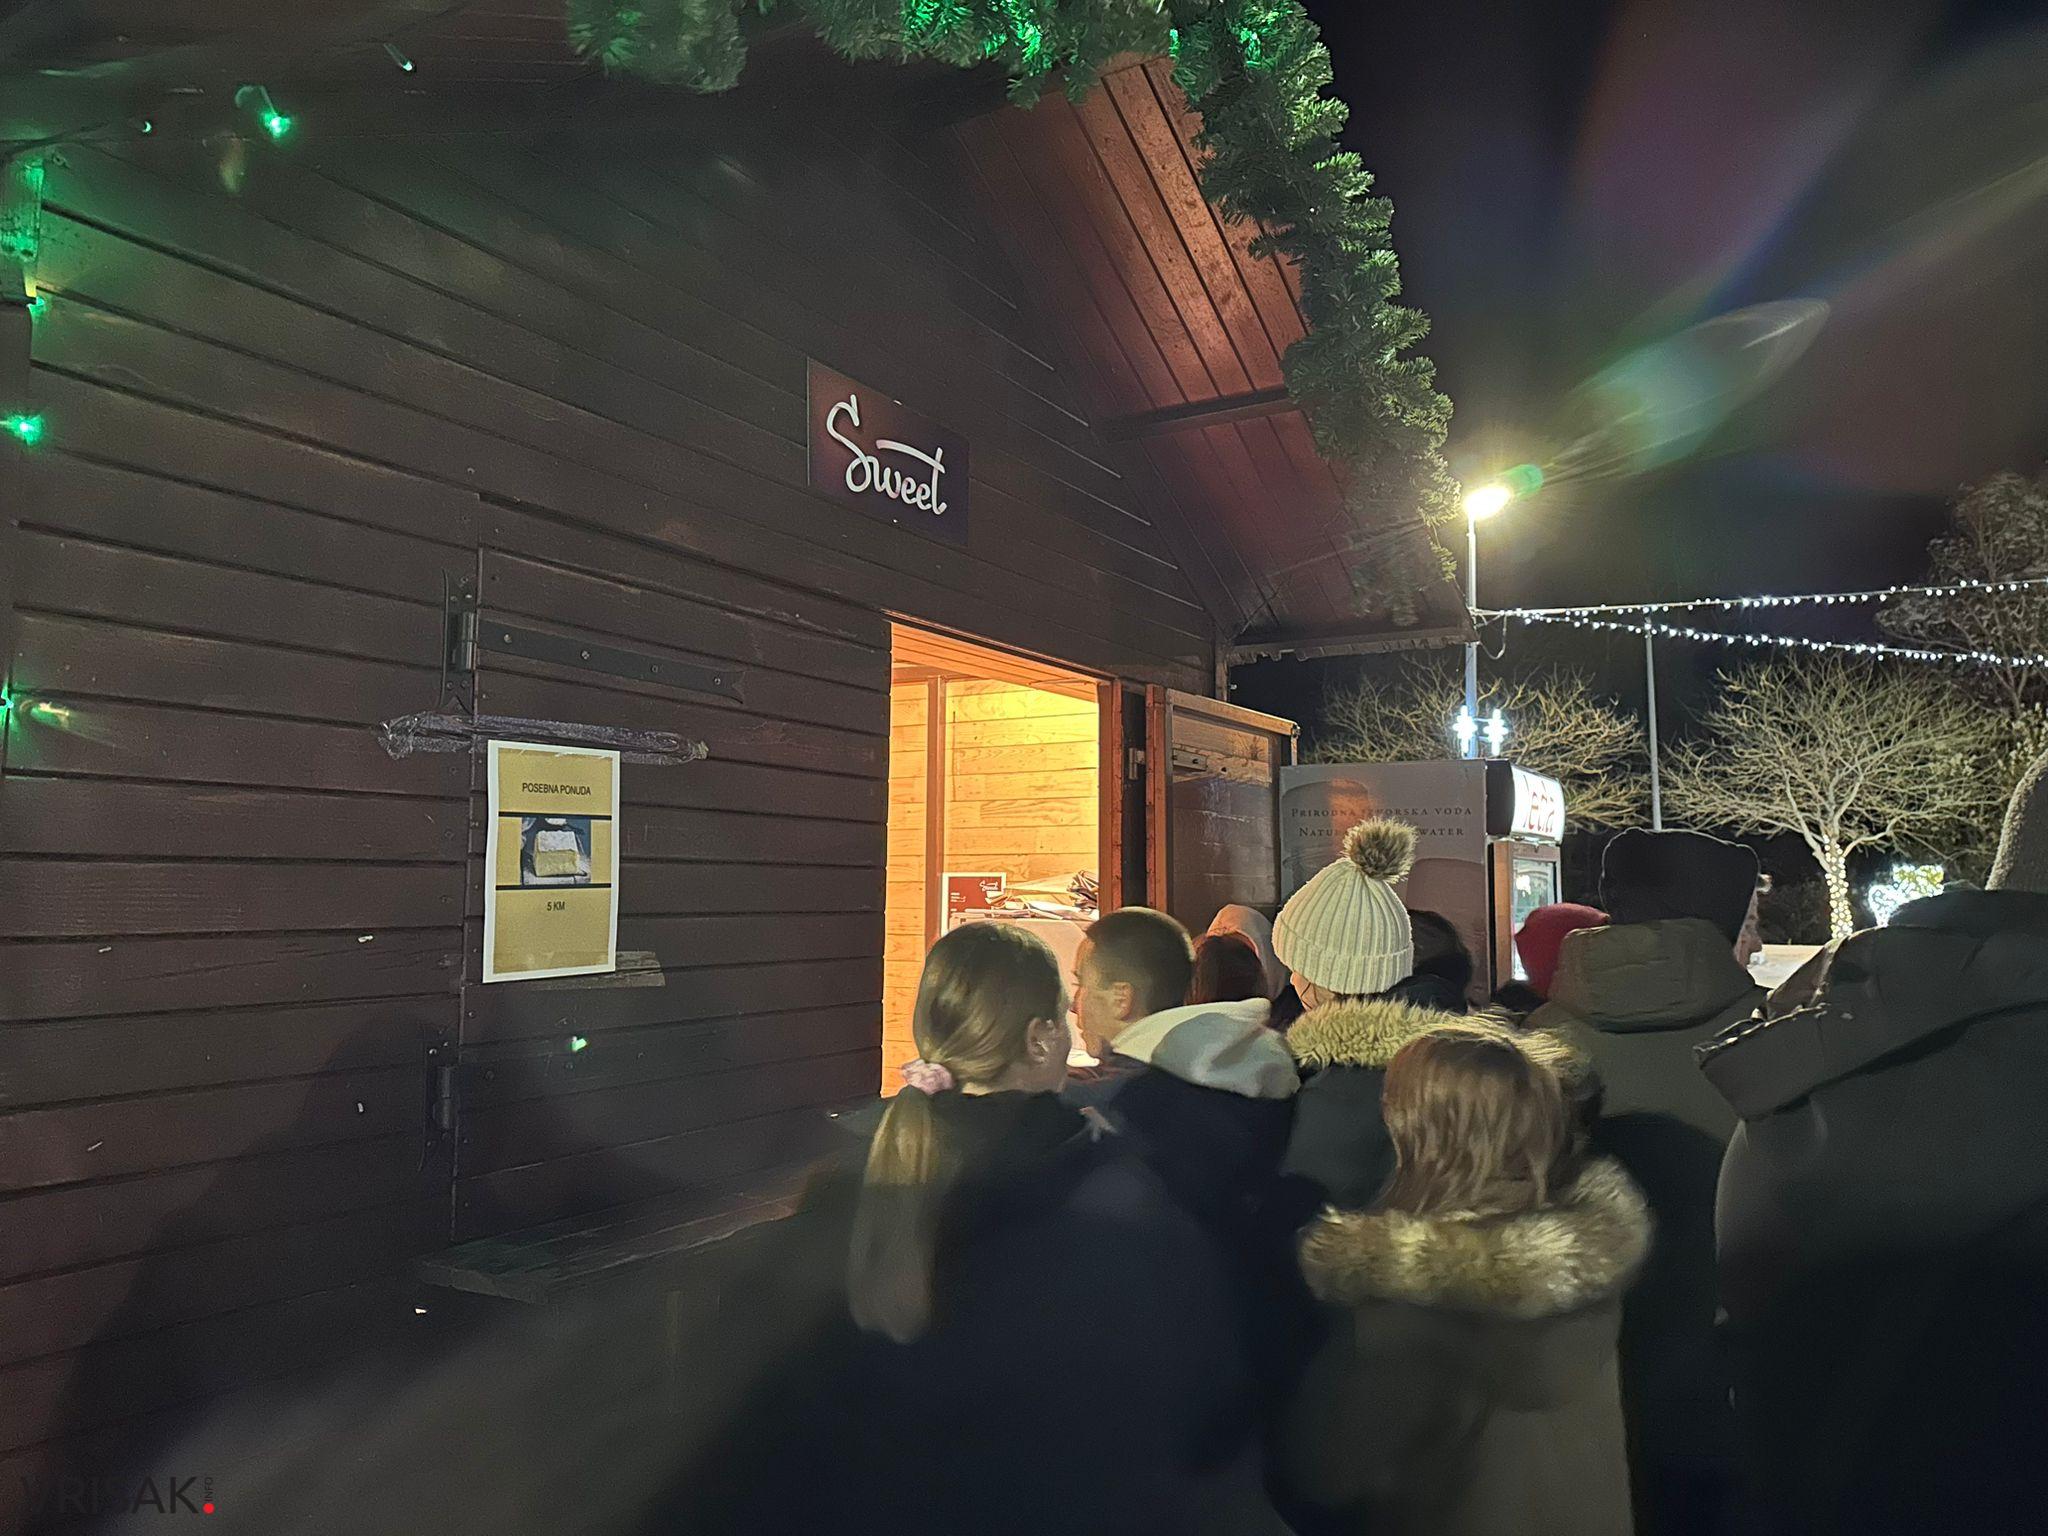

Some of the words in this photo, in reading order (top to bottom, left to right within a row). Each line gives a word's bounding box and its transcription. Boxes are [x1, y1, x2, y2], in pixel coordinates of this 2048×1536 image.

[826, 394, 948, 515] Sweet
[522, 782, 559, 794] POSEBNA
[560, 784, 591, 795] PONUDA
[1291, 807, 1357, 817] PRIRODNA
[1433, 807, 1472, 816] VODA
[546, 901, 552, 911] 5
[553, 901, 566, 911] KM
